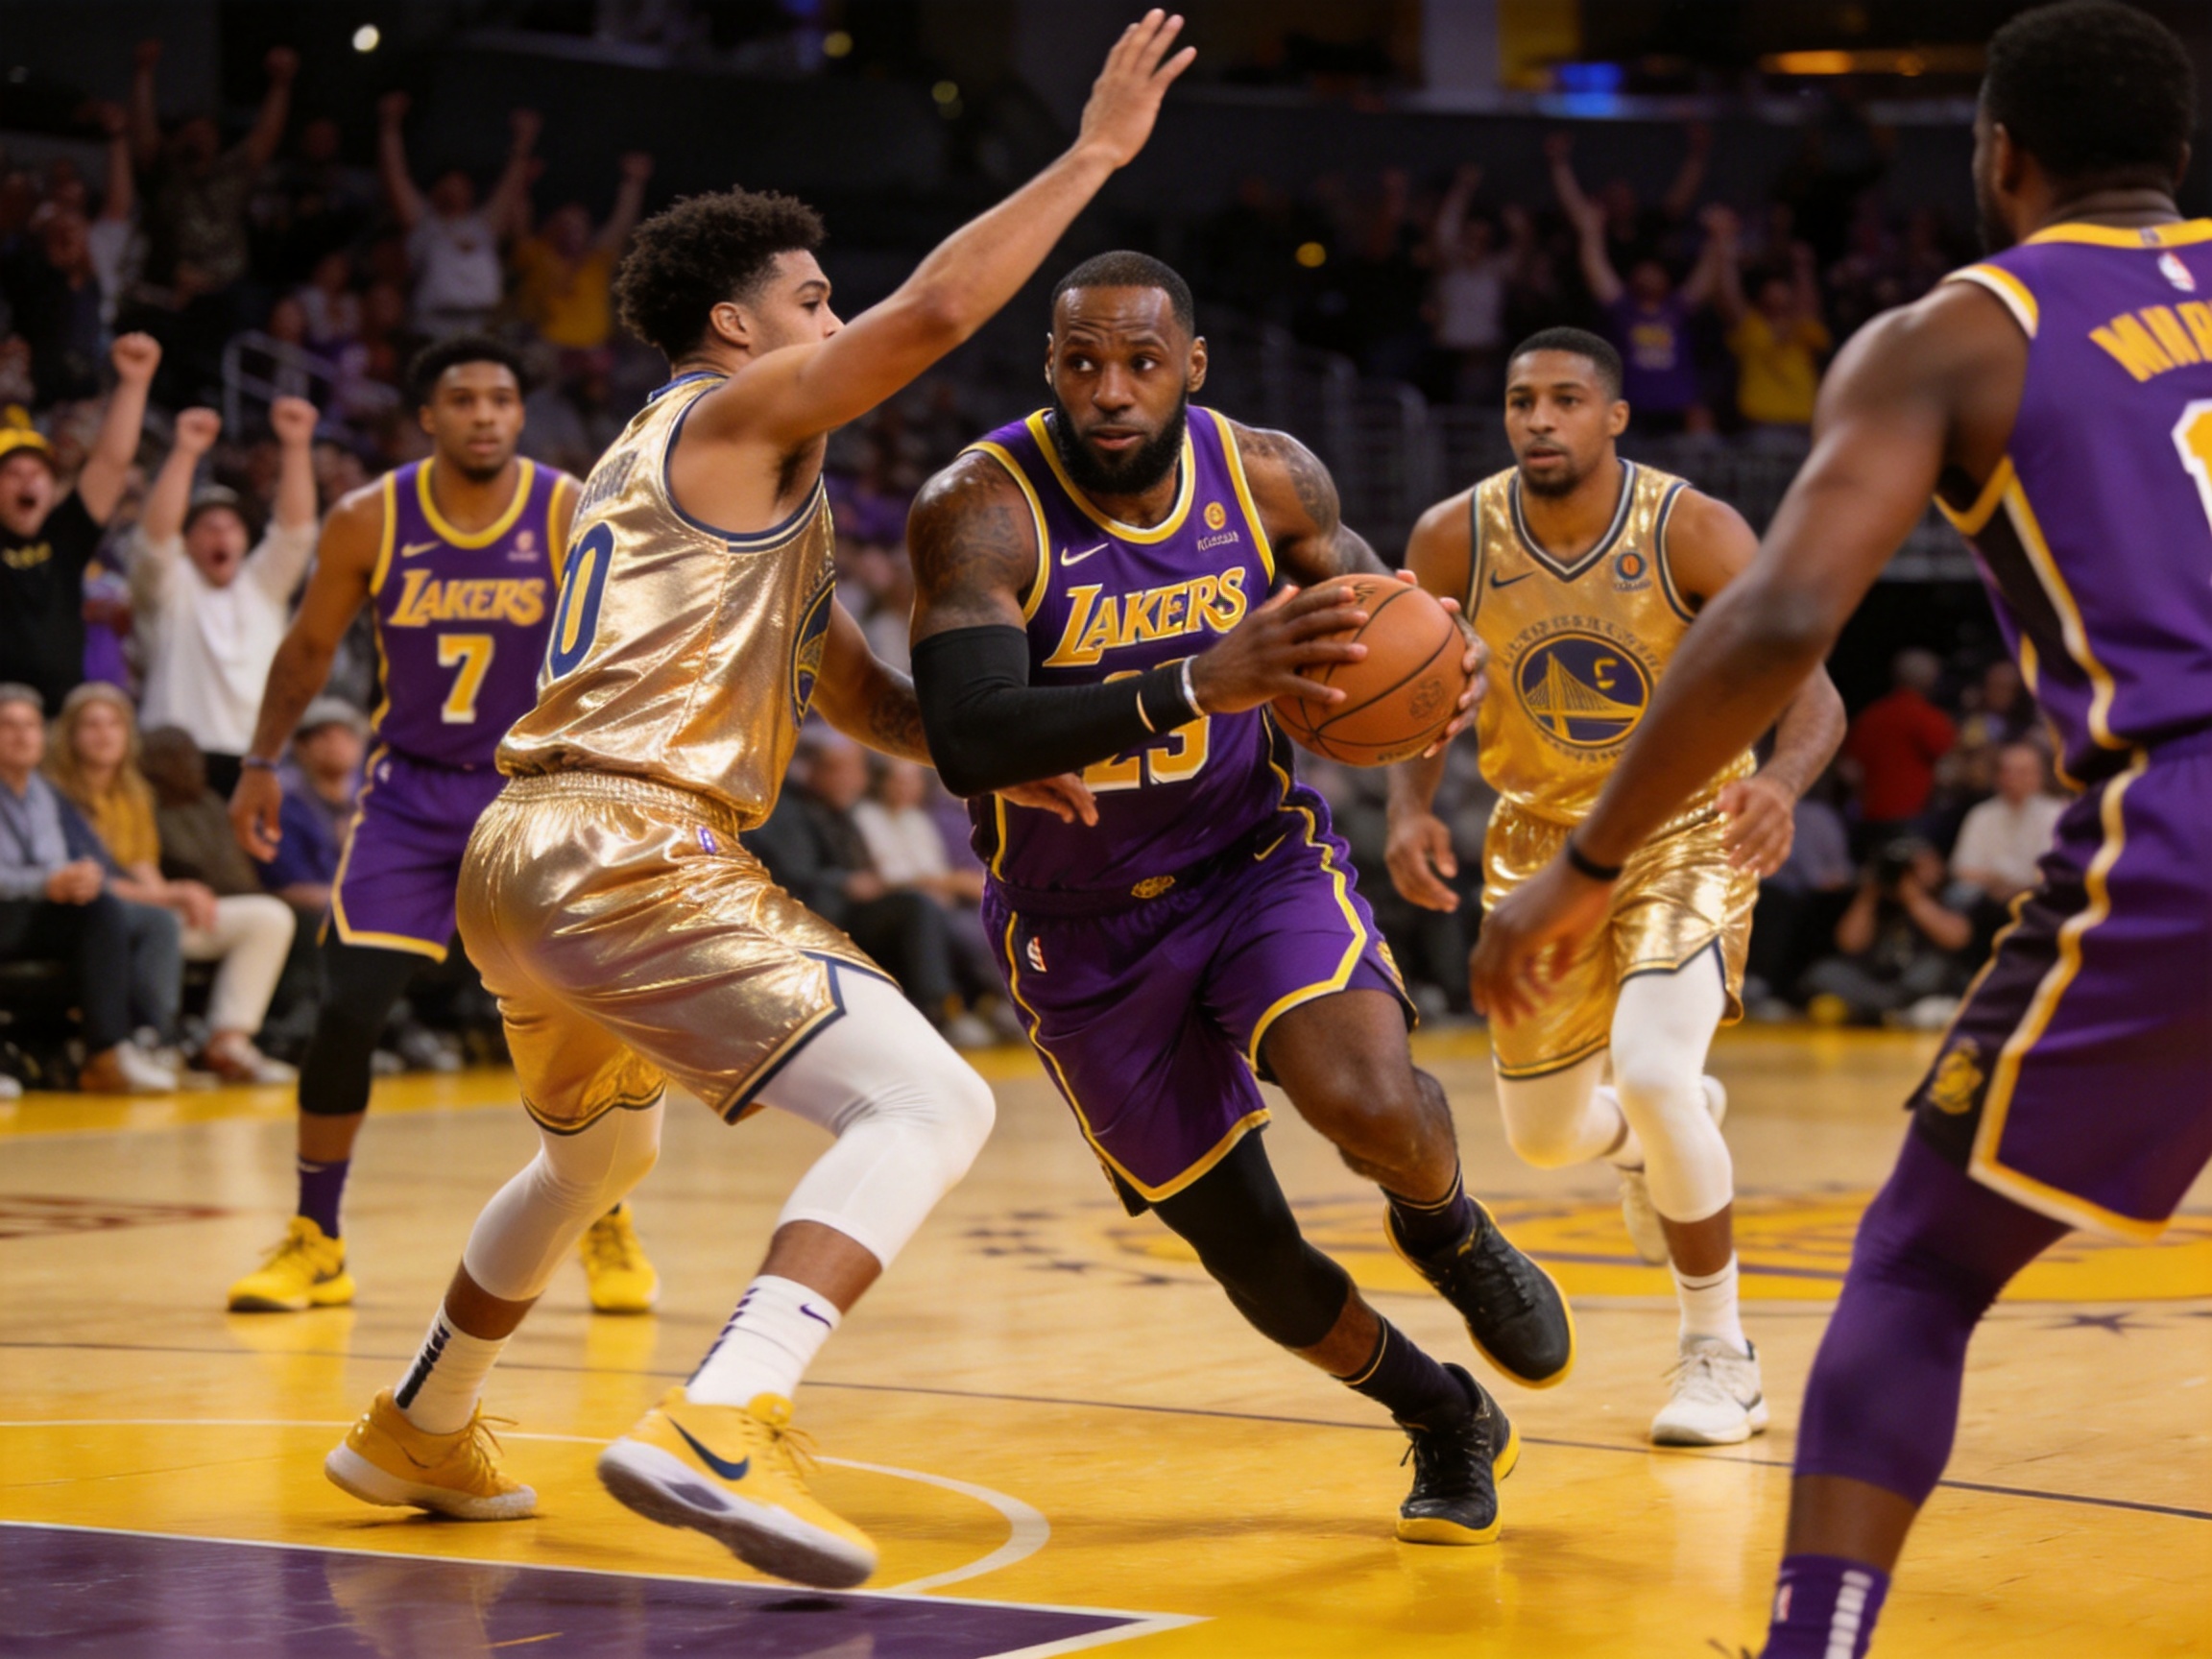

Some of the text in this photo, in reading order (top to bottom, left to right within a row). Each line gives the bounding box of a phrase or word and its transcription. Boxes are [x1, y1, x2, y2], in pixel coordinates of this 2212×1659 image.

[388, 568, 546, 628] LAKERS
[1043, 566, 1247, 667] LAKERS
[437, 633, 495, 725] 7
